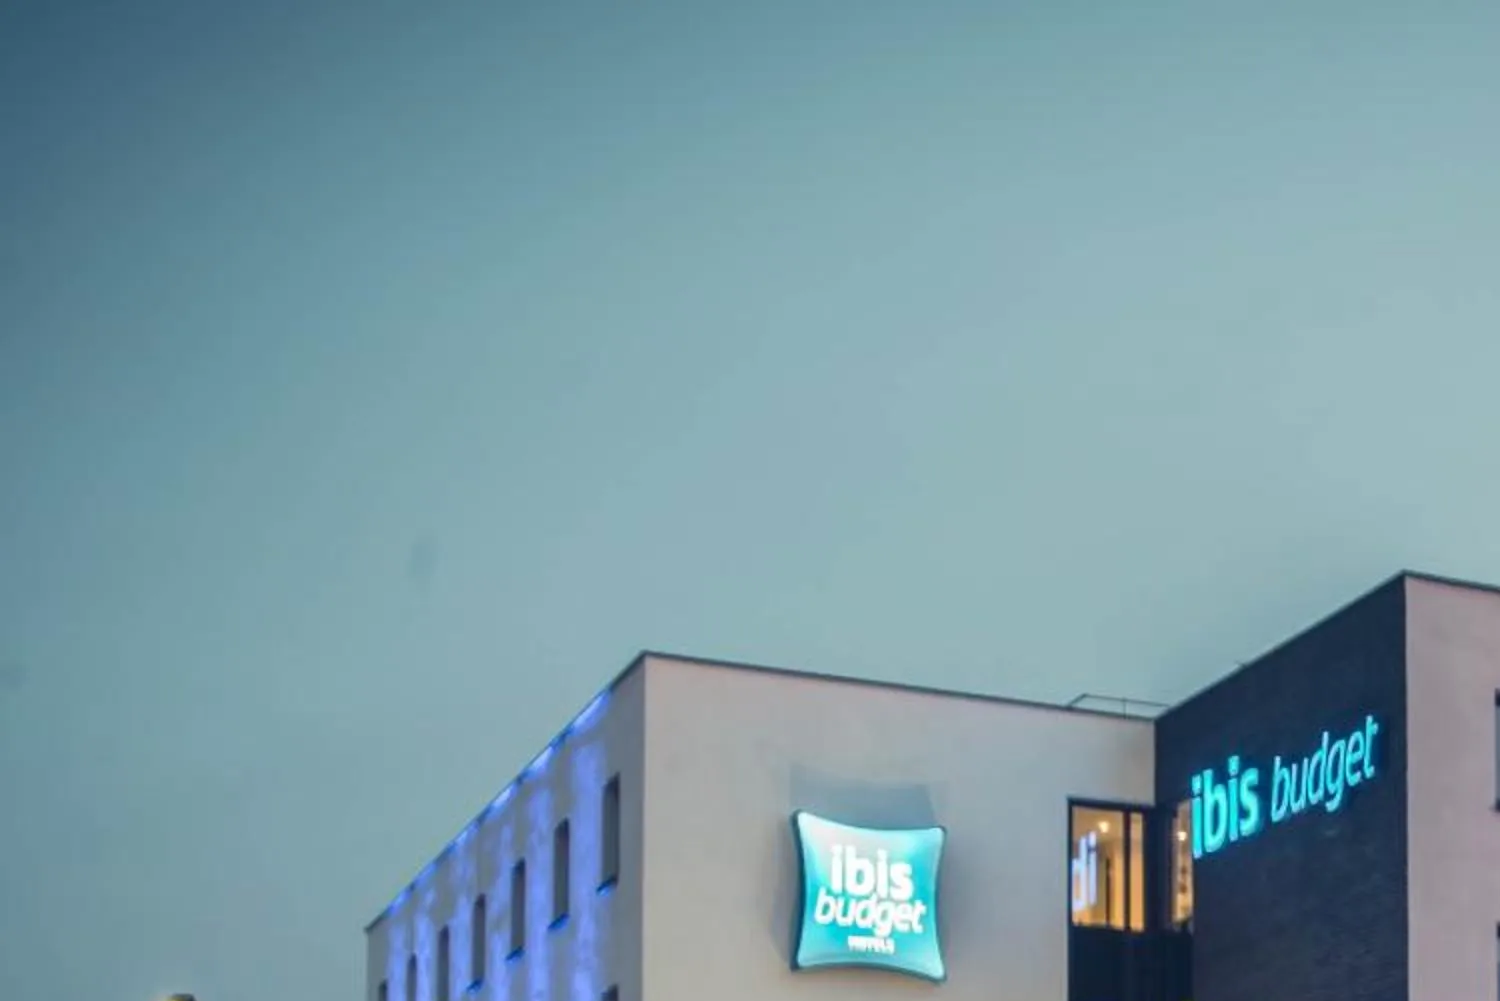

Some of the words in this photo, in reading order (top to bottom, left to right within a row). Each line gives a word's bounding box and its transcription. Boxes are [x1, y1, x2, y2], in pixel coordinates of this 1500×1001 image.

[1191, 755, 1260, 860] ibis
[1270, 714, 1379, 823] budget
[831, 844, 915, 901] ibis
[814, 886, 928, 938] budget
